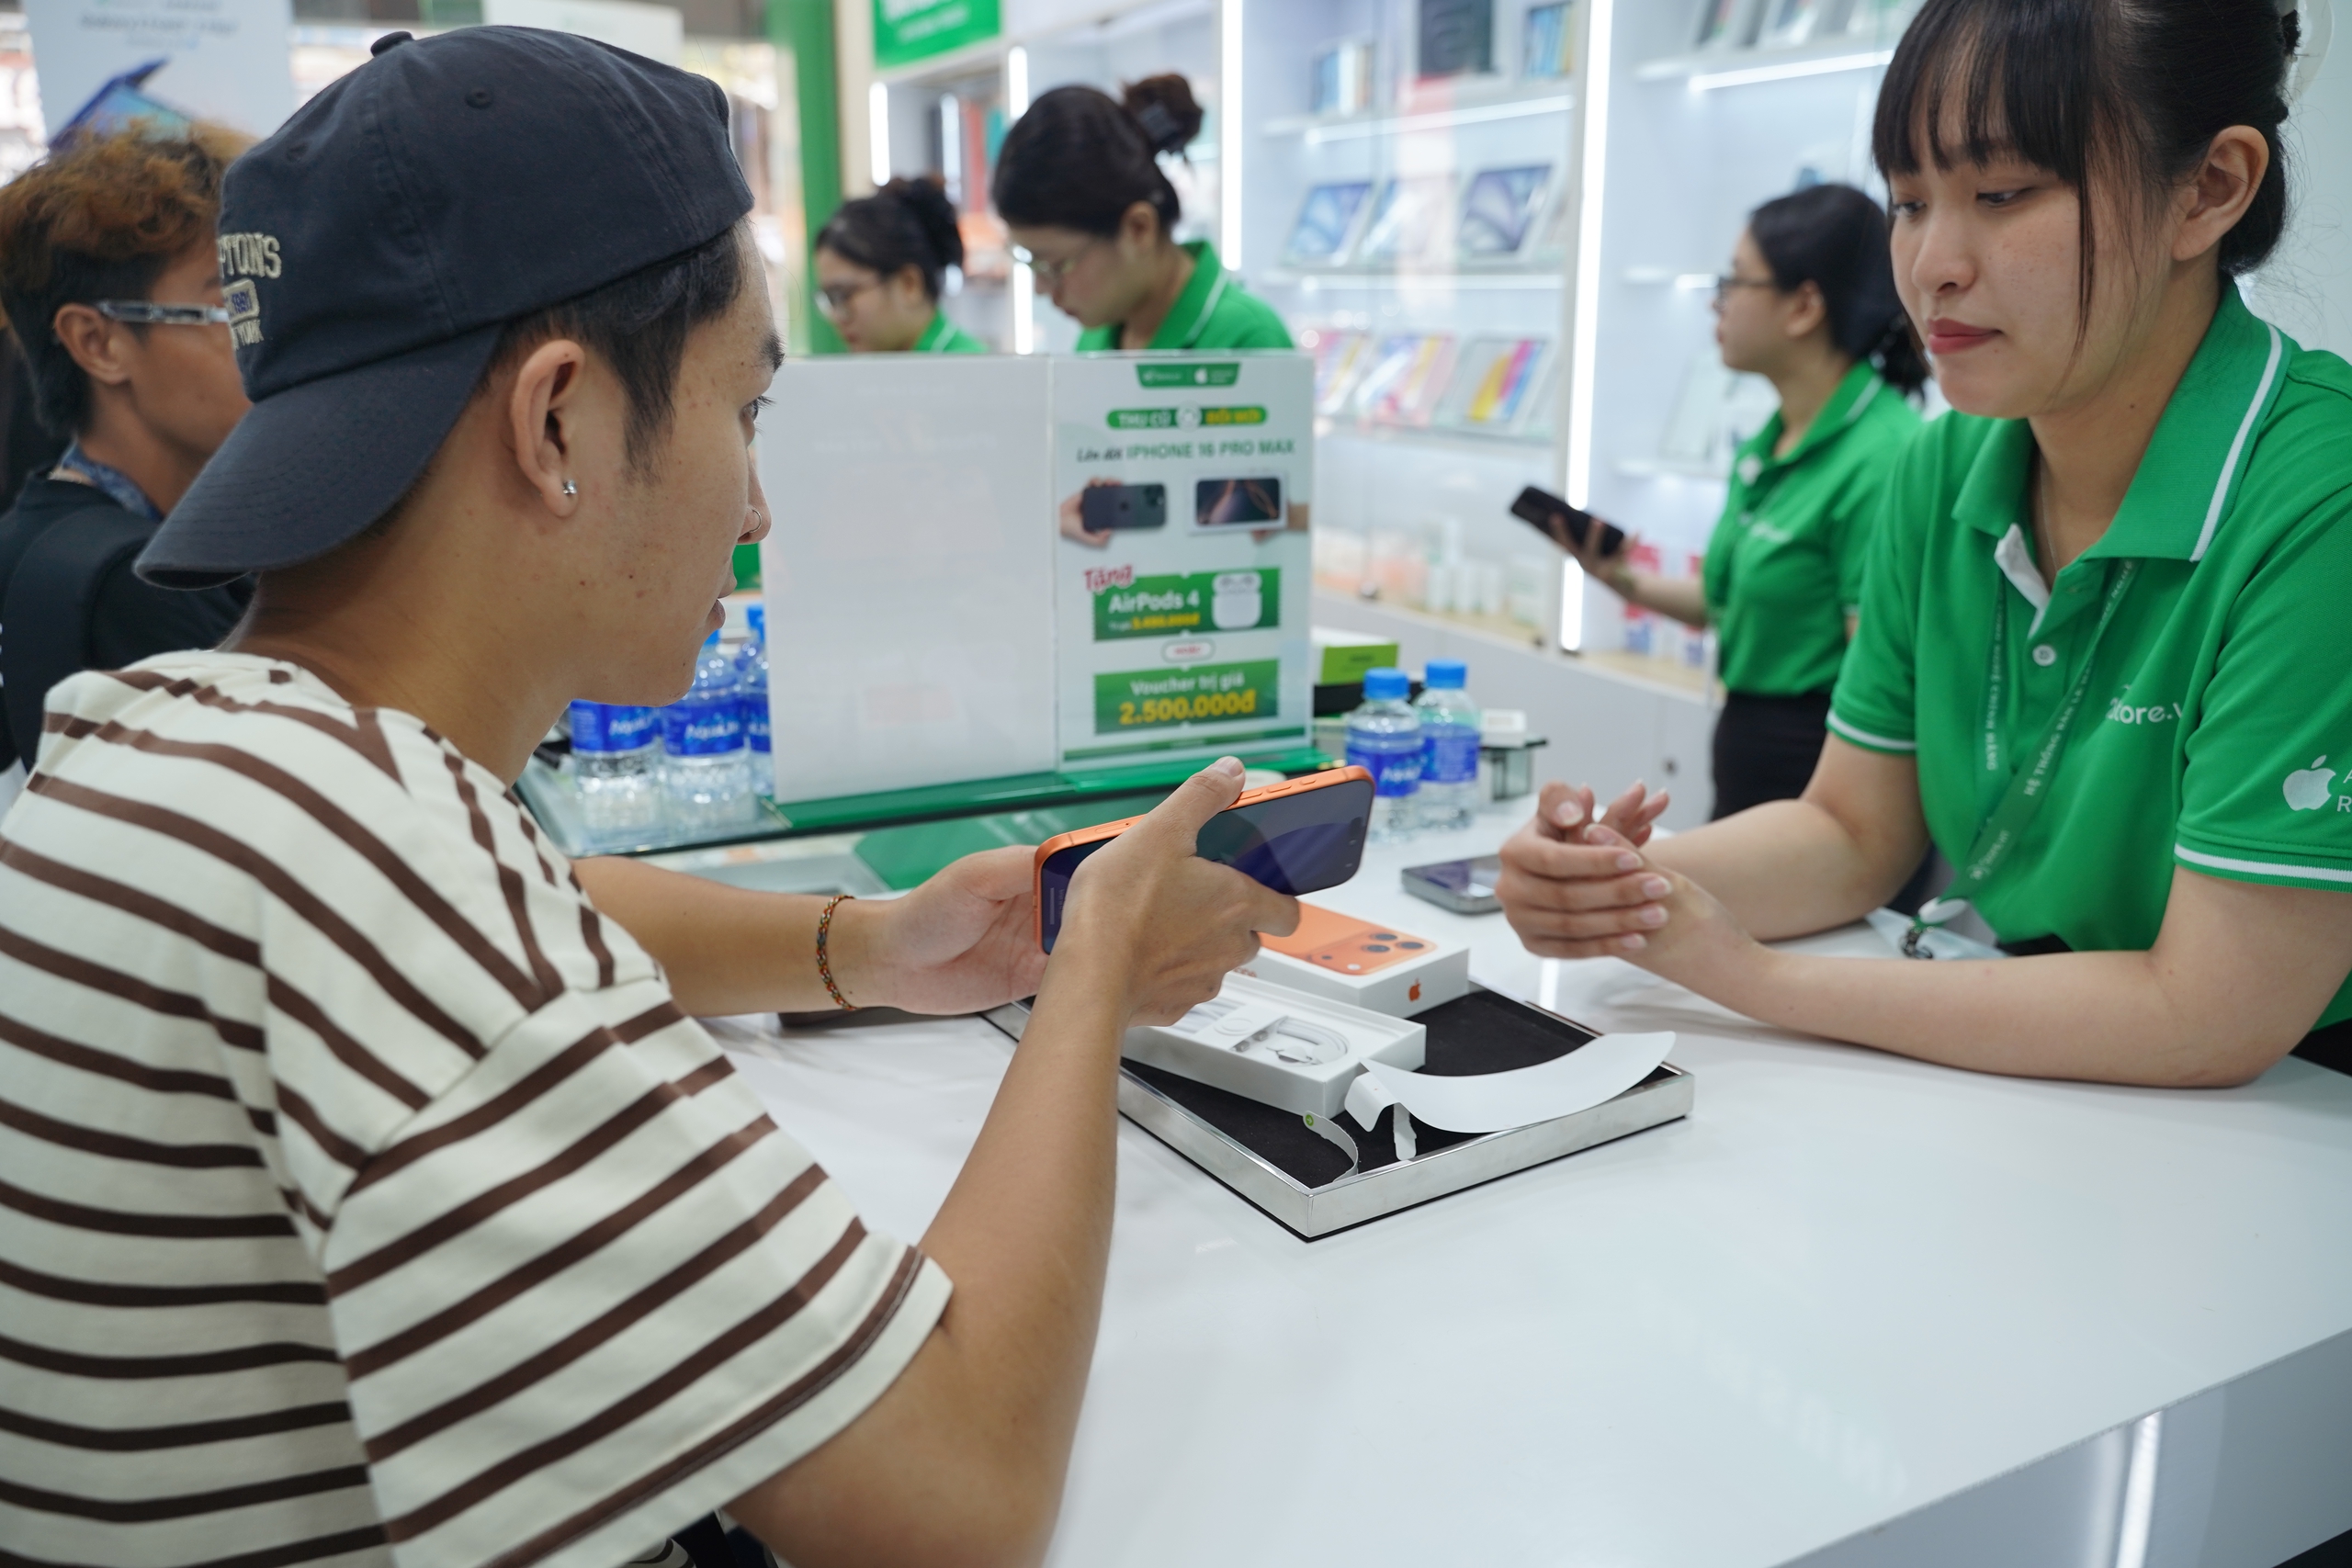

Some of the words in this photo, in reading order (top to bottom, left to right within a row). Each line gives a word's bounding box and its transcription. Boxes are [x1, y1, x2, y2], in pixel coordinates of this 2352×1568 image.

[1126, 442, 1193, 459] IPHONE
[1219, 439, 1255, 457] PRO
[1258, 437, 1295, 456] MAX
[1108, 590, 1184, 614] AirPods
[1186, 589, 1200, 608] 4
[1130, 676, 1195, 696] Voucher
[1119, 688, 1257, 725] 2.500.000đ
